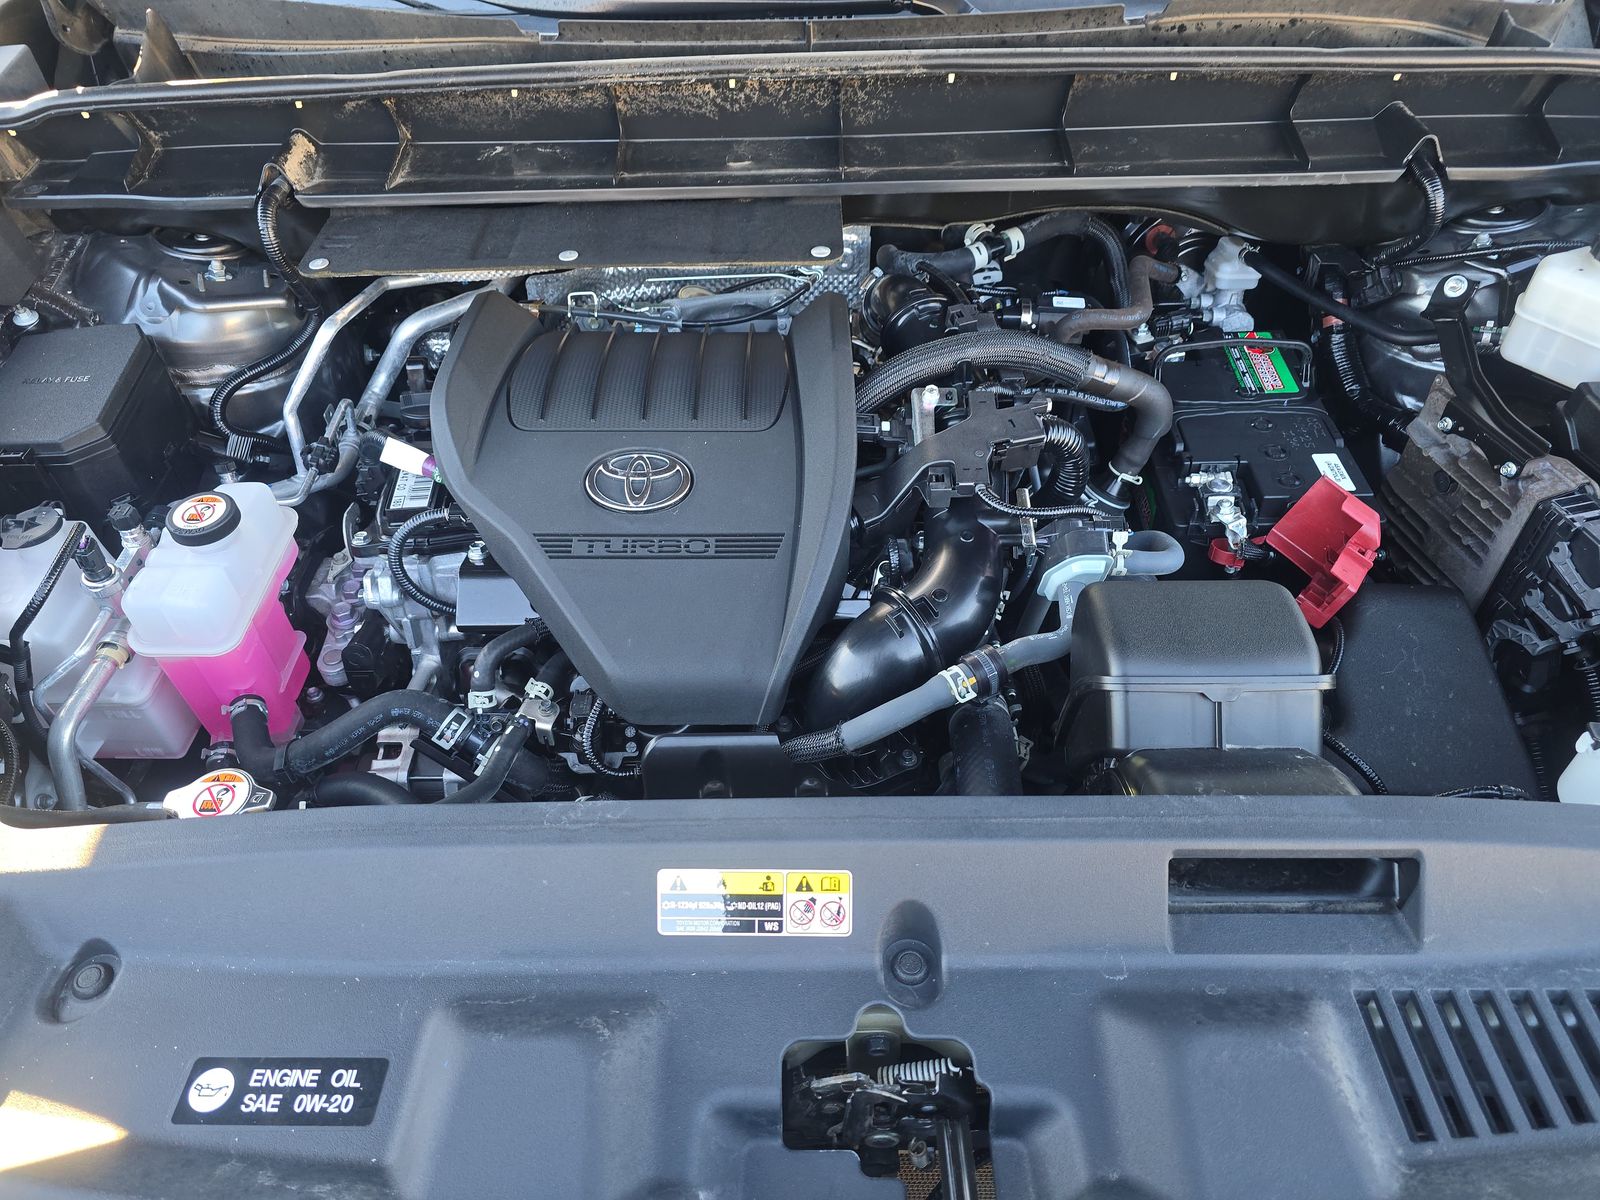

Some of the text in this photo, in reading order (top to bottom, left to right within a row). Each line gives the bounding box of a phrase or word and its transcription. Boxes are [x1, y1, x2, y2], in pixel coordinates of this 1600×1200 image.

[64, 375, 91, 383] FUSE
[577, 539, 711, 554] TURBO
[765, 902, 781, 911] (PAG)
[765, 922, 779, 931] WS
[249, 1069, 361, 1088] ENGINE OIL
[240, 1094, 354, 1113] SAE 0W-20
